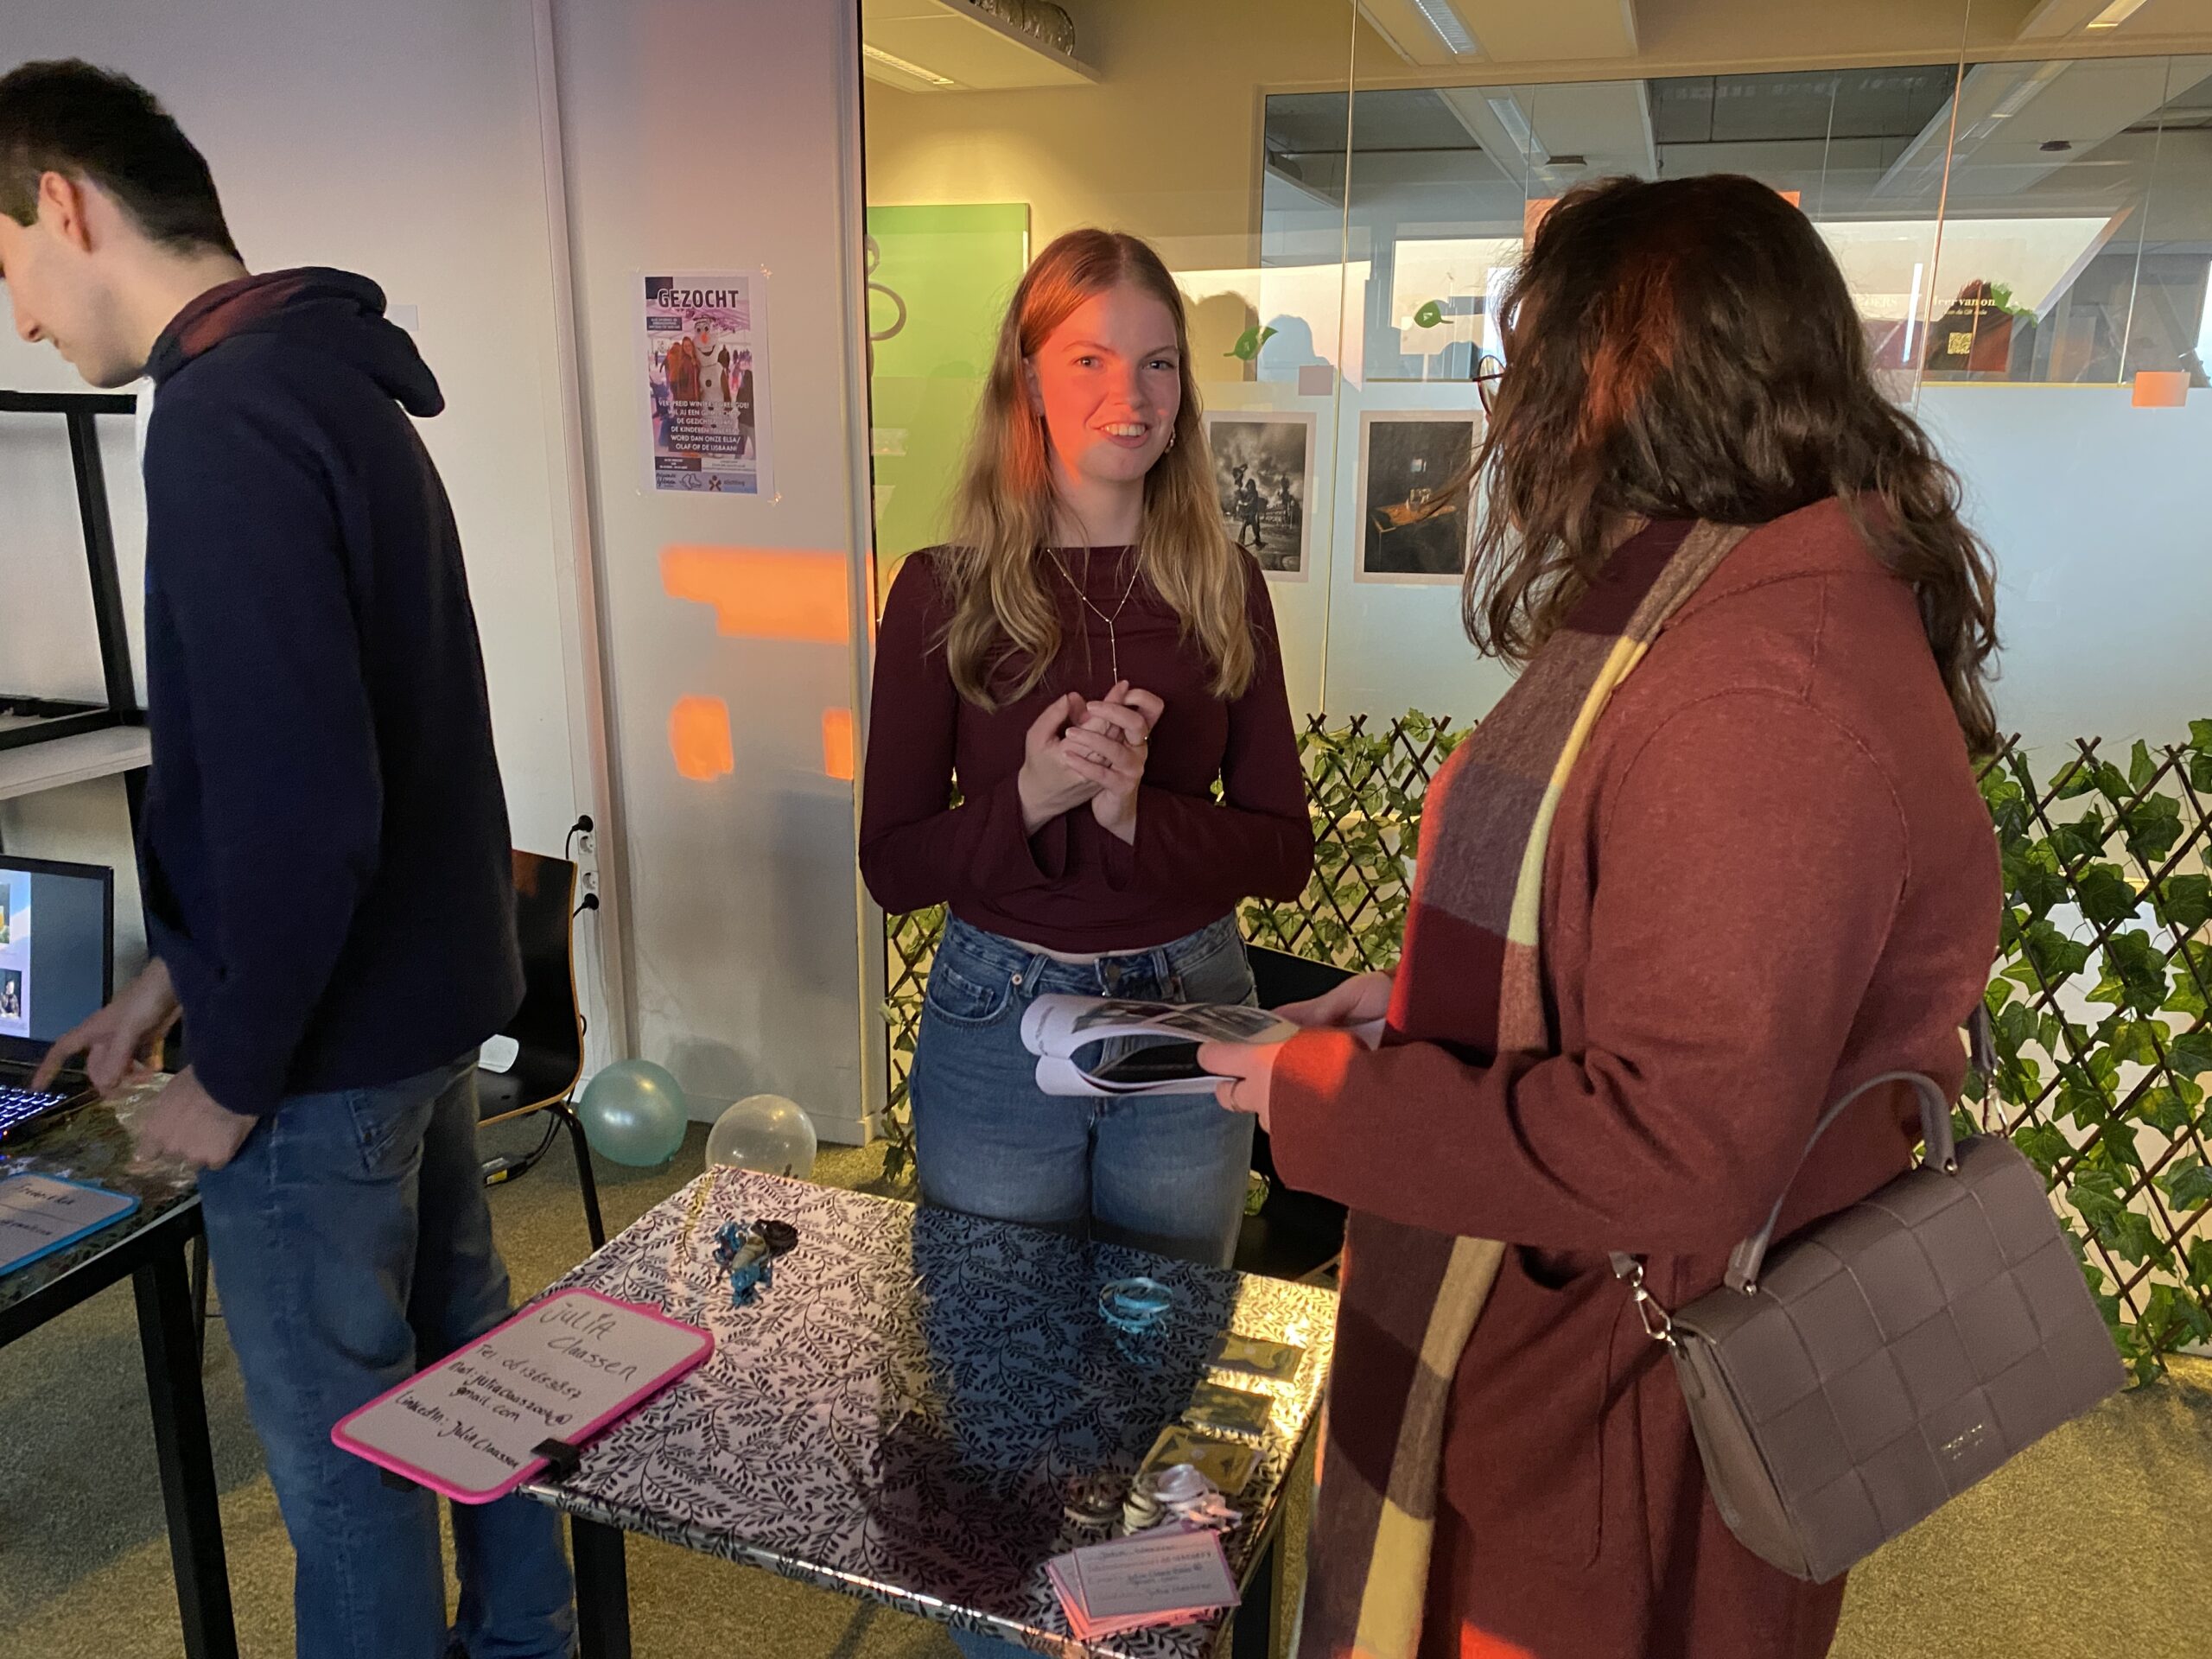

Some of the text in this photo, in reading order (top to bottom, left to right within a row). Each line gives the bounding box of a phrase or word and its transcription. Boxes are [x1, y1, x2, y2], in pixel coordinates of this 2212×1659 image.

[658, 289, 739, 308] GEZOCHT
[1958, 297, 1979, 307] van
[547, 1336, 638, 1382] Claassen
